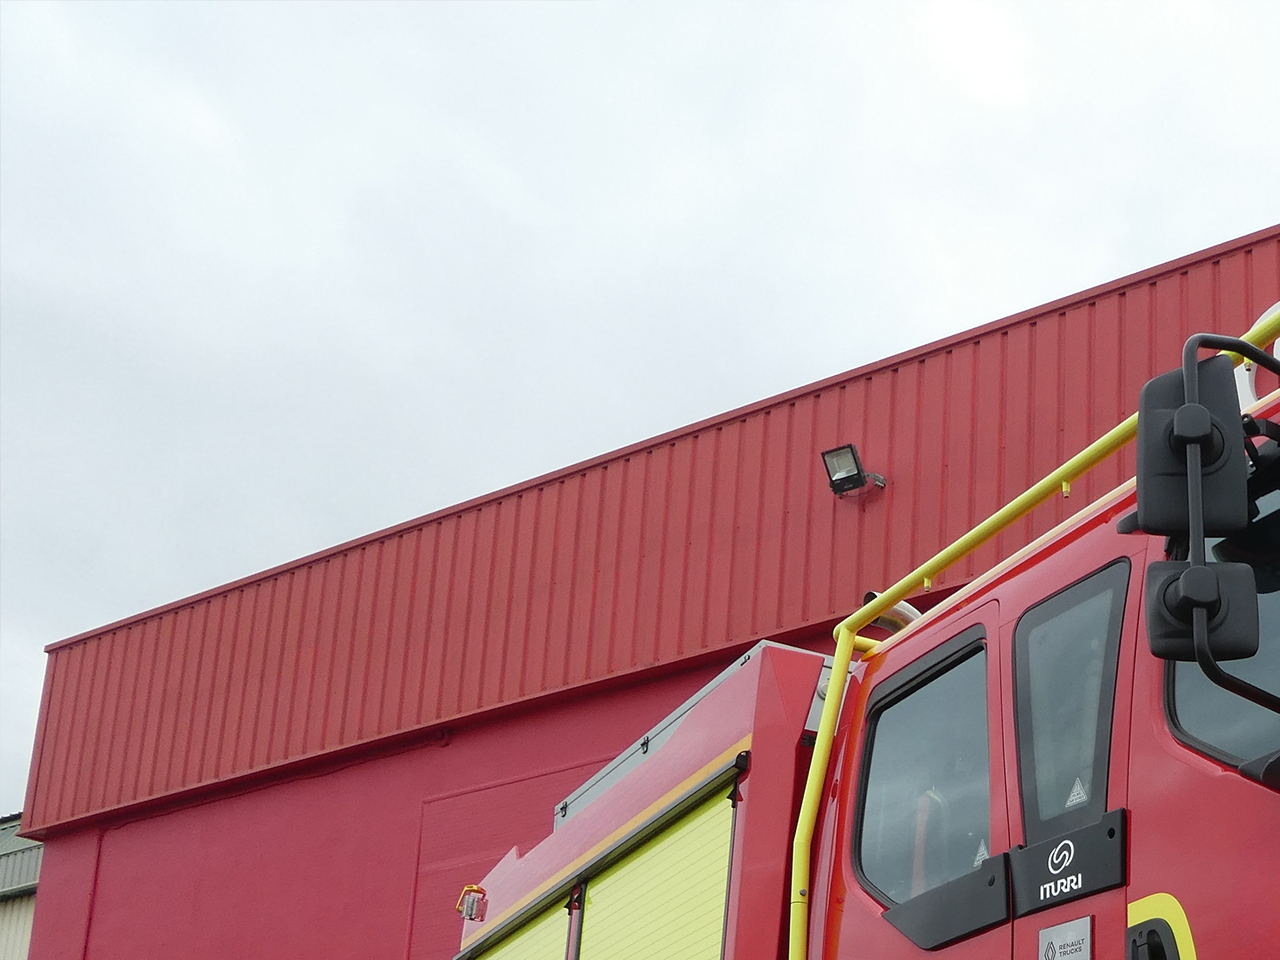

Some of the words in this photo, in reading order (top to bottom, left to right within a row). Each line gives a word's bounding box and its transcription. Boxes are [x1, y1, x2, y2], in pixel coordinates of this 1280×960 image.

[1040, 873, 1082, 900] ITURRI
[1058, 938, 1085, 951] RENAULT
[1059, 946, 1083, 957] TRUCKS
